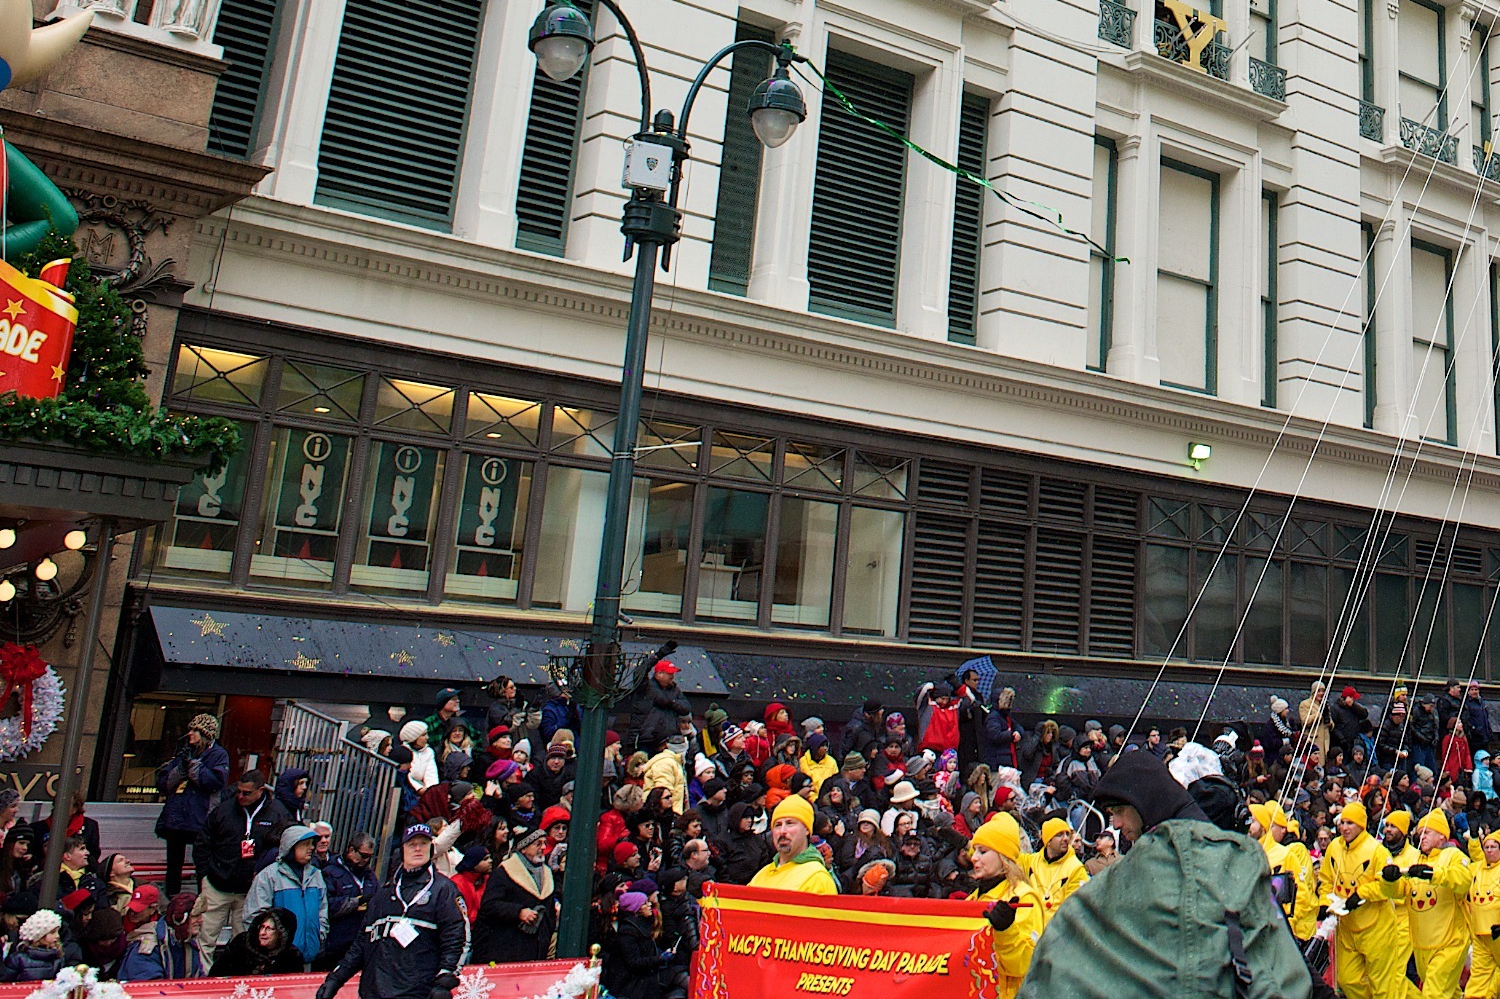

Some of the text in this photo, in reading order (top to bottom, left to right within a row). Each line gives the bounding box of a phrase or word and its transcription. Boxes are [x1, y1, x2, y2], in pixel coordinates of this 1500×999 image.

[197, 463, 228, 518] YC
[295, 464, 325, 527] NYC
[387, 475, 416, 537] NYC
[474, 487, 501, 547] NYC
[407, 823, 430, 835] NYPD
[728, 934, 951, 975] MACY'S THANKSGIVING DAY PARADE
[796, 972, 855, 997] PRESENTS
